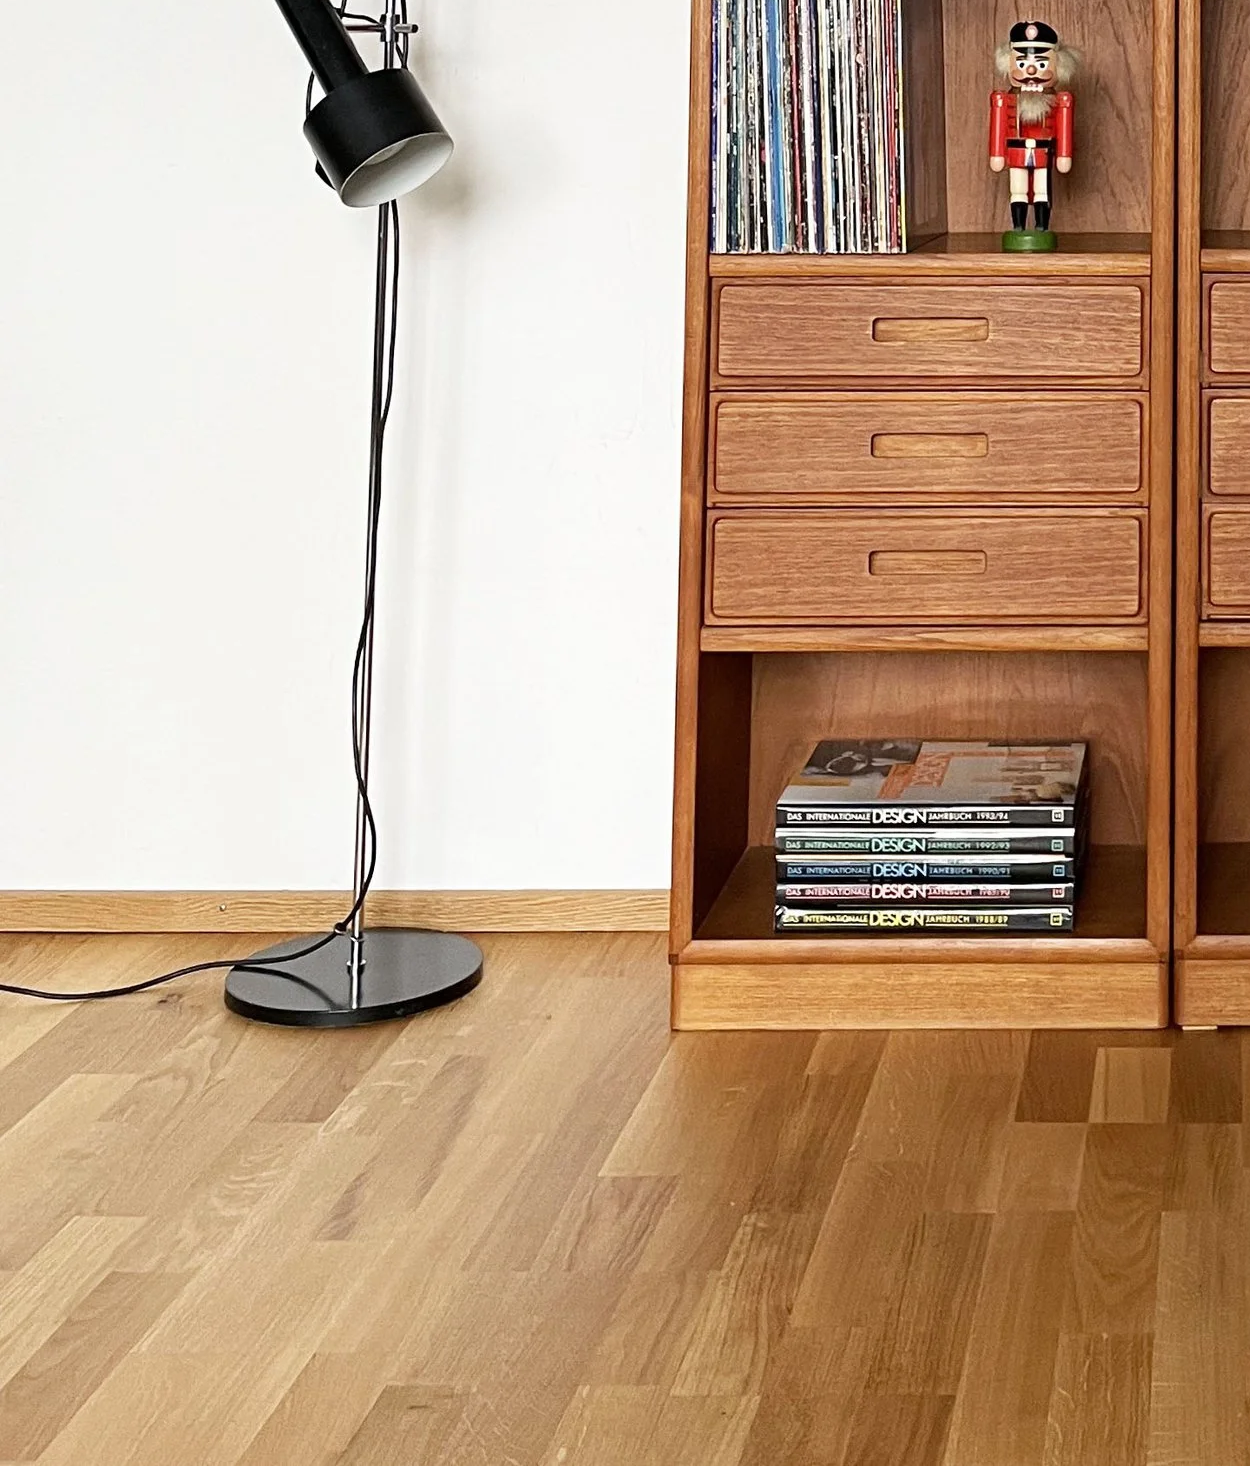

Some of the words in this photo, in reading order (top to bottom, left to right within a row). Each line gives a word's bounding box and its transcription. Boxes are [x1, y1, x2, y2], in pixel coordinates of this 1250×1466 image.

[873, 809, 926, 823] DESIGN
[928, 812, 971, 820] JAHRBUCH
[805, 841, 869, 849] INTERNATIONALE
[871, 838, 925, 852] DESIGN
[873, 863, 926, 876] DESIGN
[786, 887, 801, 895] DAS
[805, 887, 869, 895] INTERNATIONALE
[871, 884, 926, 898] DESIGN
[803, 915, 868, 923] INTERNATIONALE
[870, 911, 924, 926] DESIGN
[926, 915, 969, 923] JAHRBUCH
